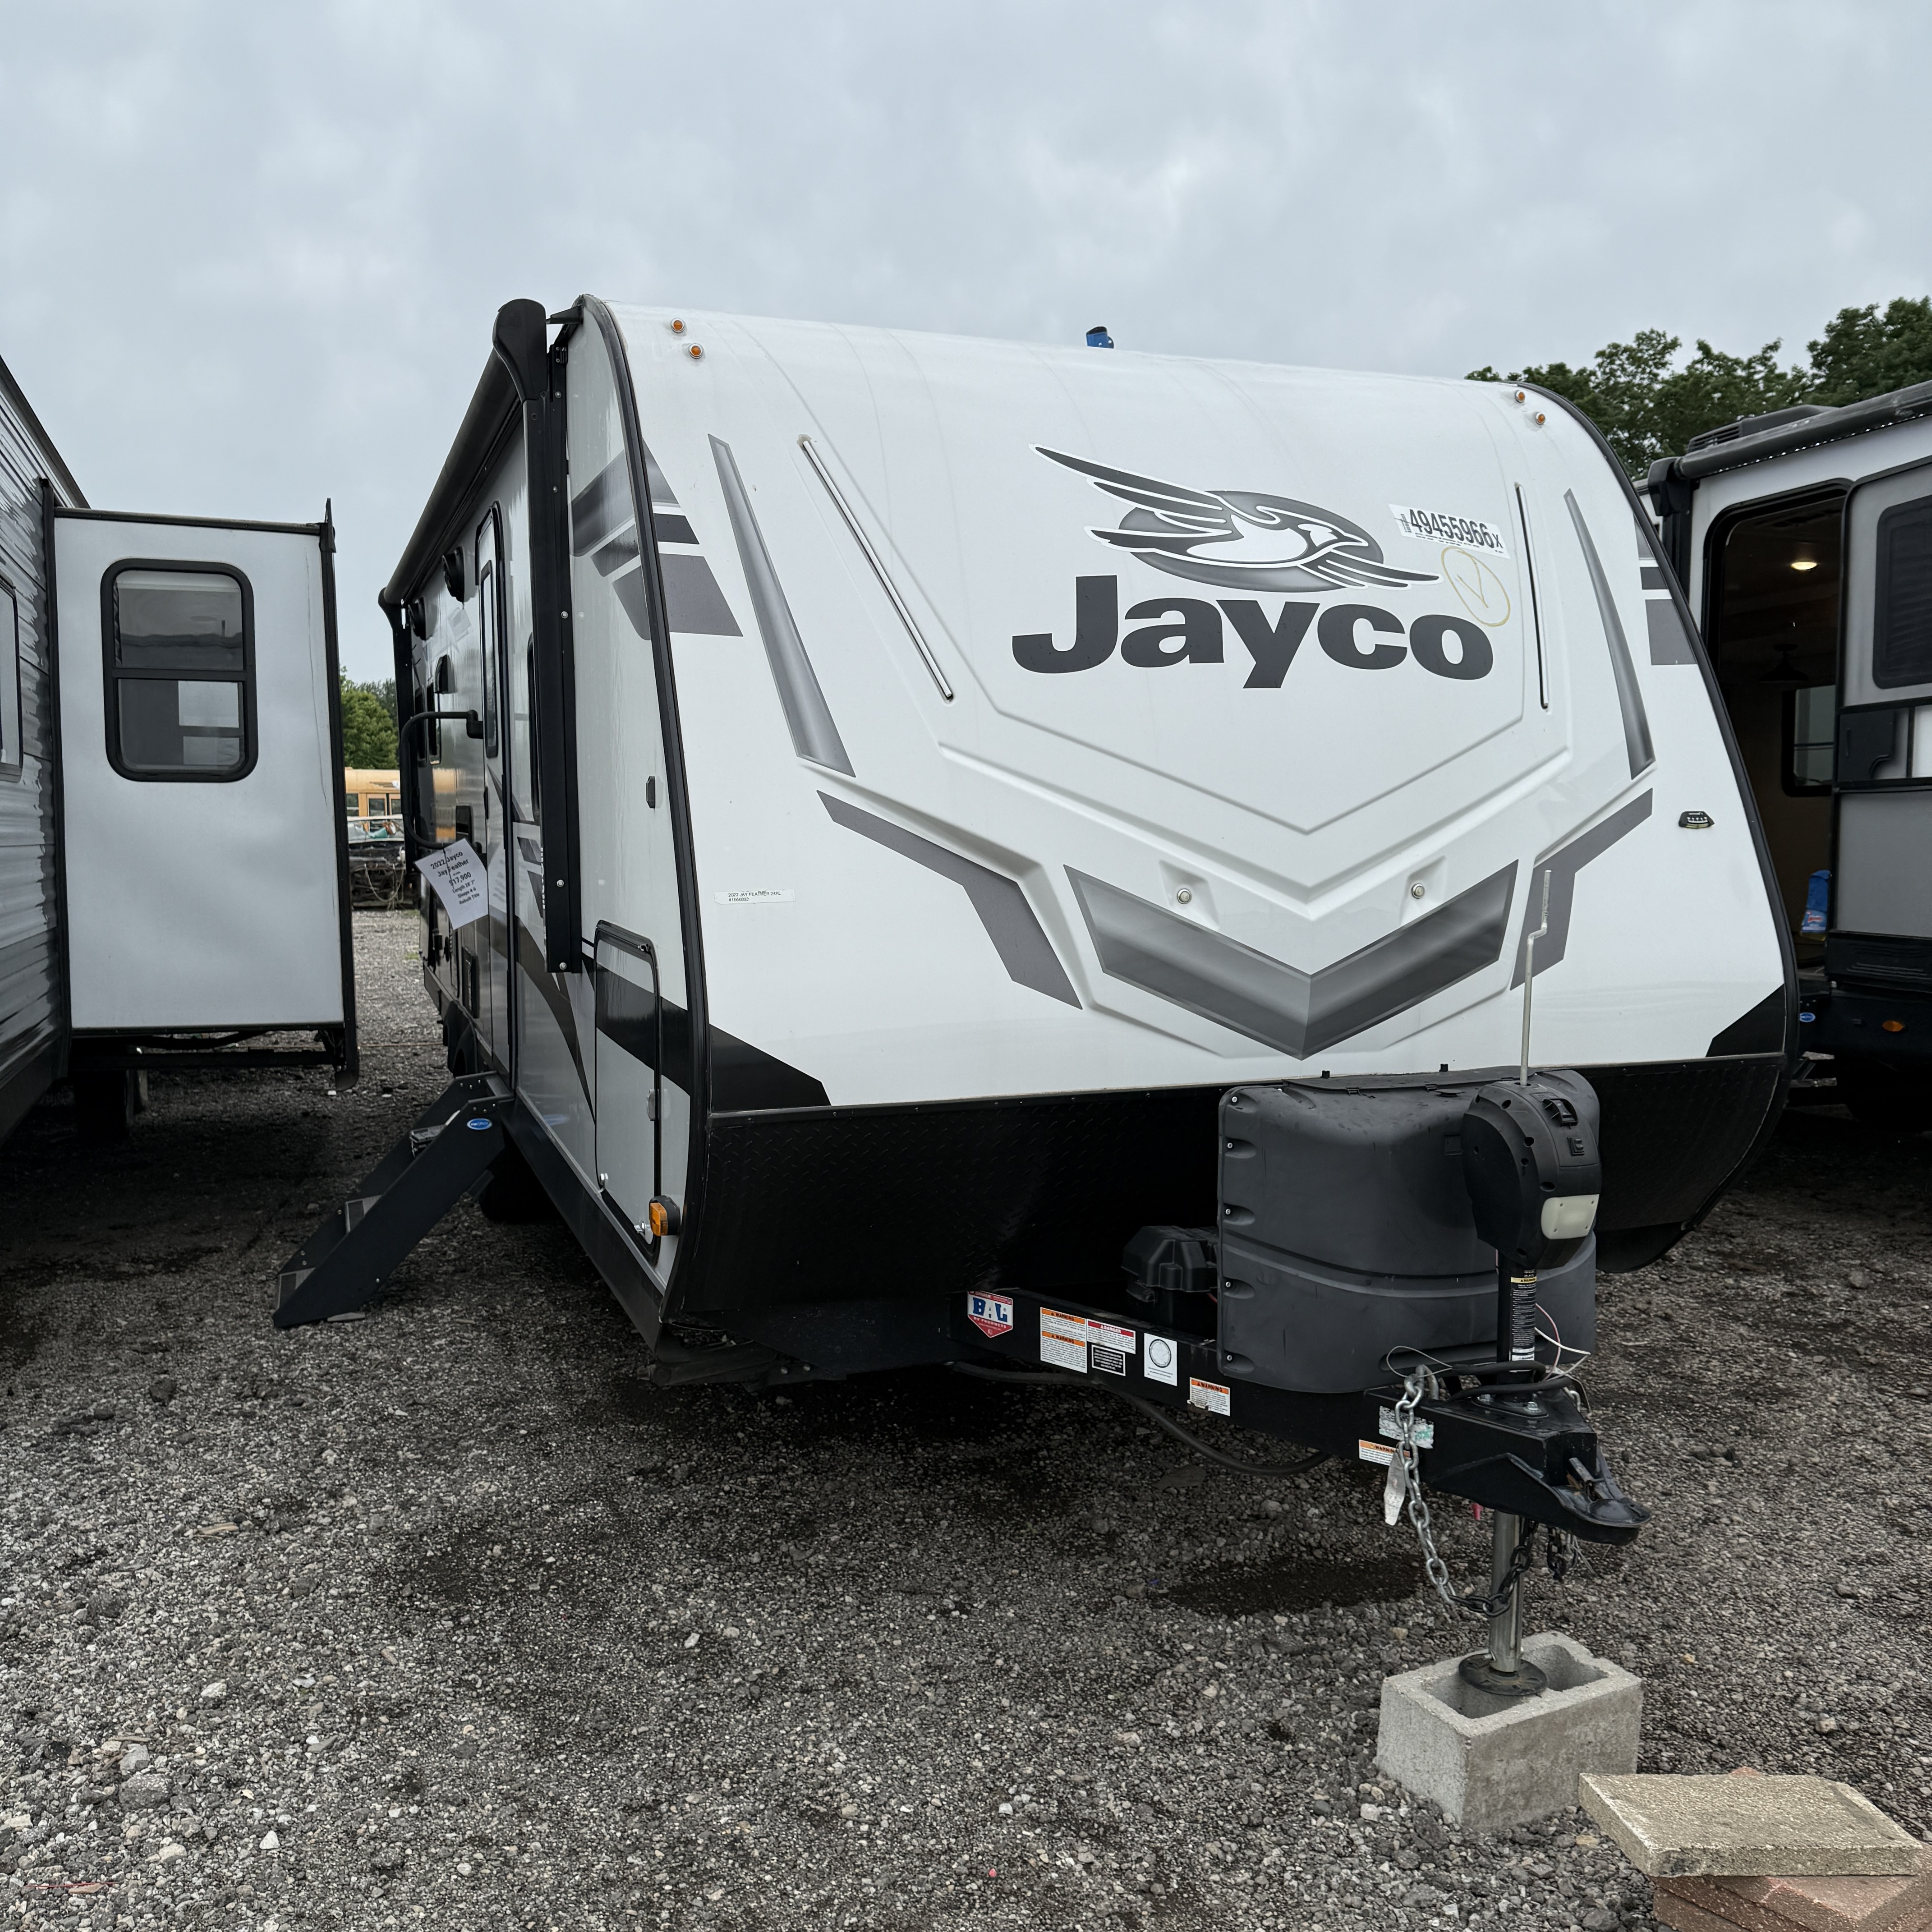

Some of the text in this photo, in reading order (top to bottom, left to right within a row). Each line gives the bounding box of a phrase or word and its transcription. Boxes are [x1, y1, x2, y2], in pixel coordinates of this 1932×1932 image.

[1012, 575, 1494, 689] Jayco
[431, 851, 463, 869] 2022 Jayco
[447, 859, 469, 872] Feather
[449, 872, 471, 886] $17,900
[973, 1297, 1008, 1323] BAL
[1375, 1444, 1395, 1453] WARNIN
